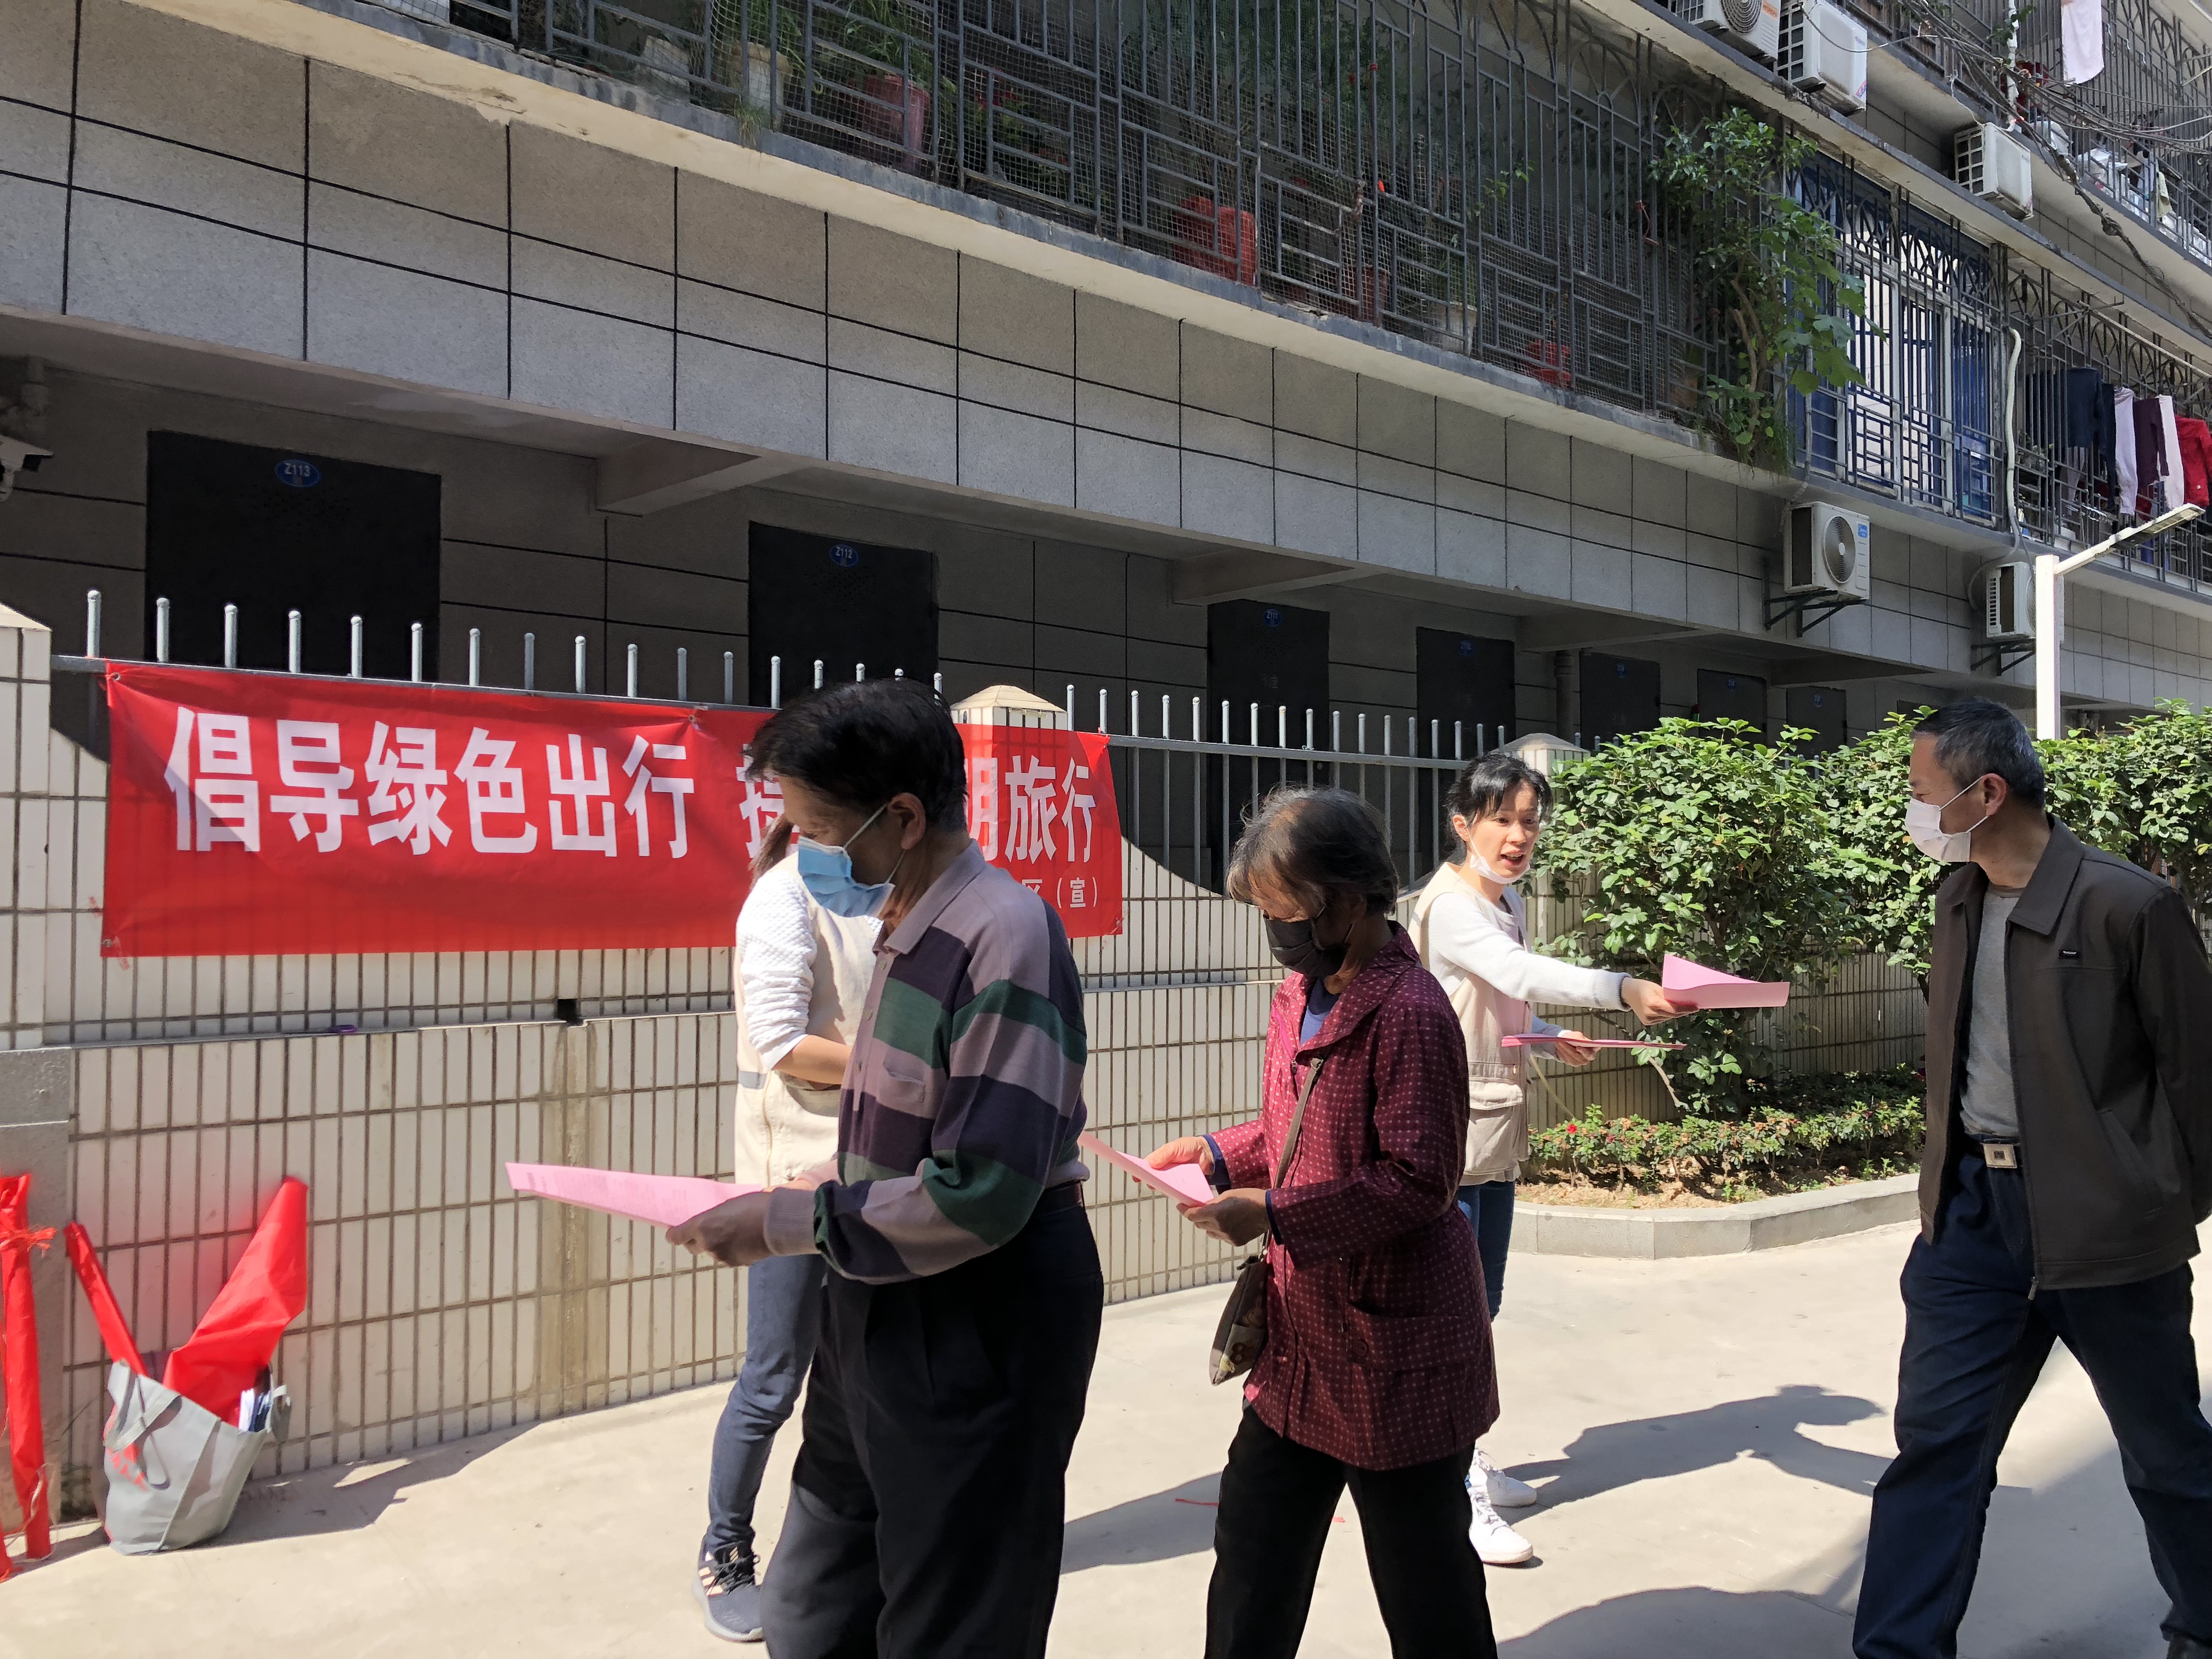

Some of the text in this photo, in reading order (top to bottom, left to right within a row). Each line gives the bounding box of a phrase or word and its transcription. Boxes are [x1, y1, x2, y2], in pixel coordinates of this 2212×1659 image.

[164, 706, 695, 858] 倡导绿色出行
